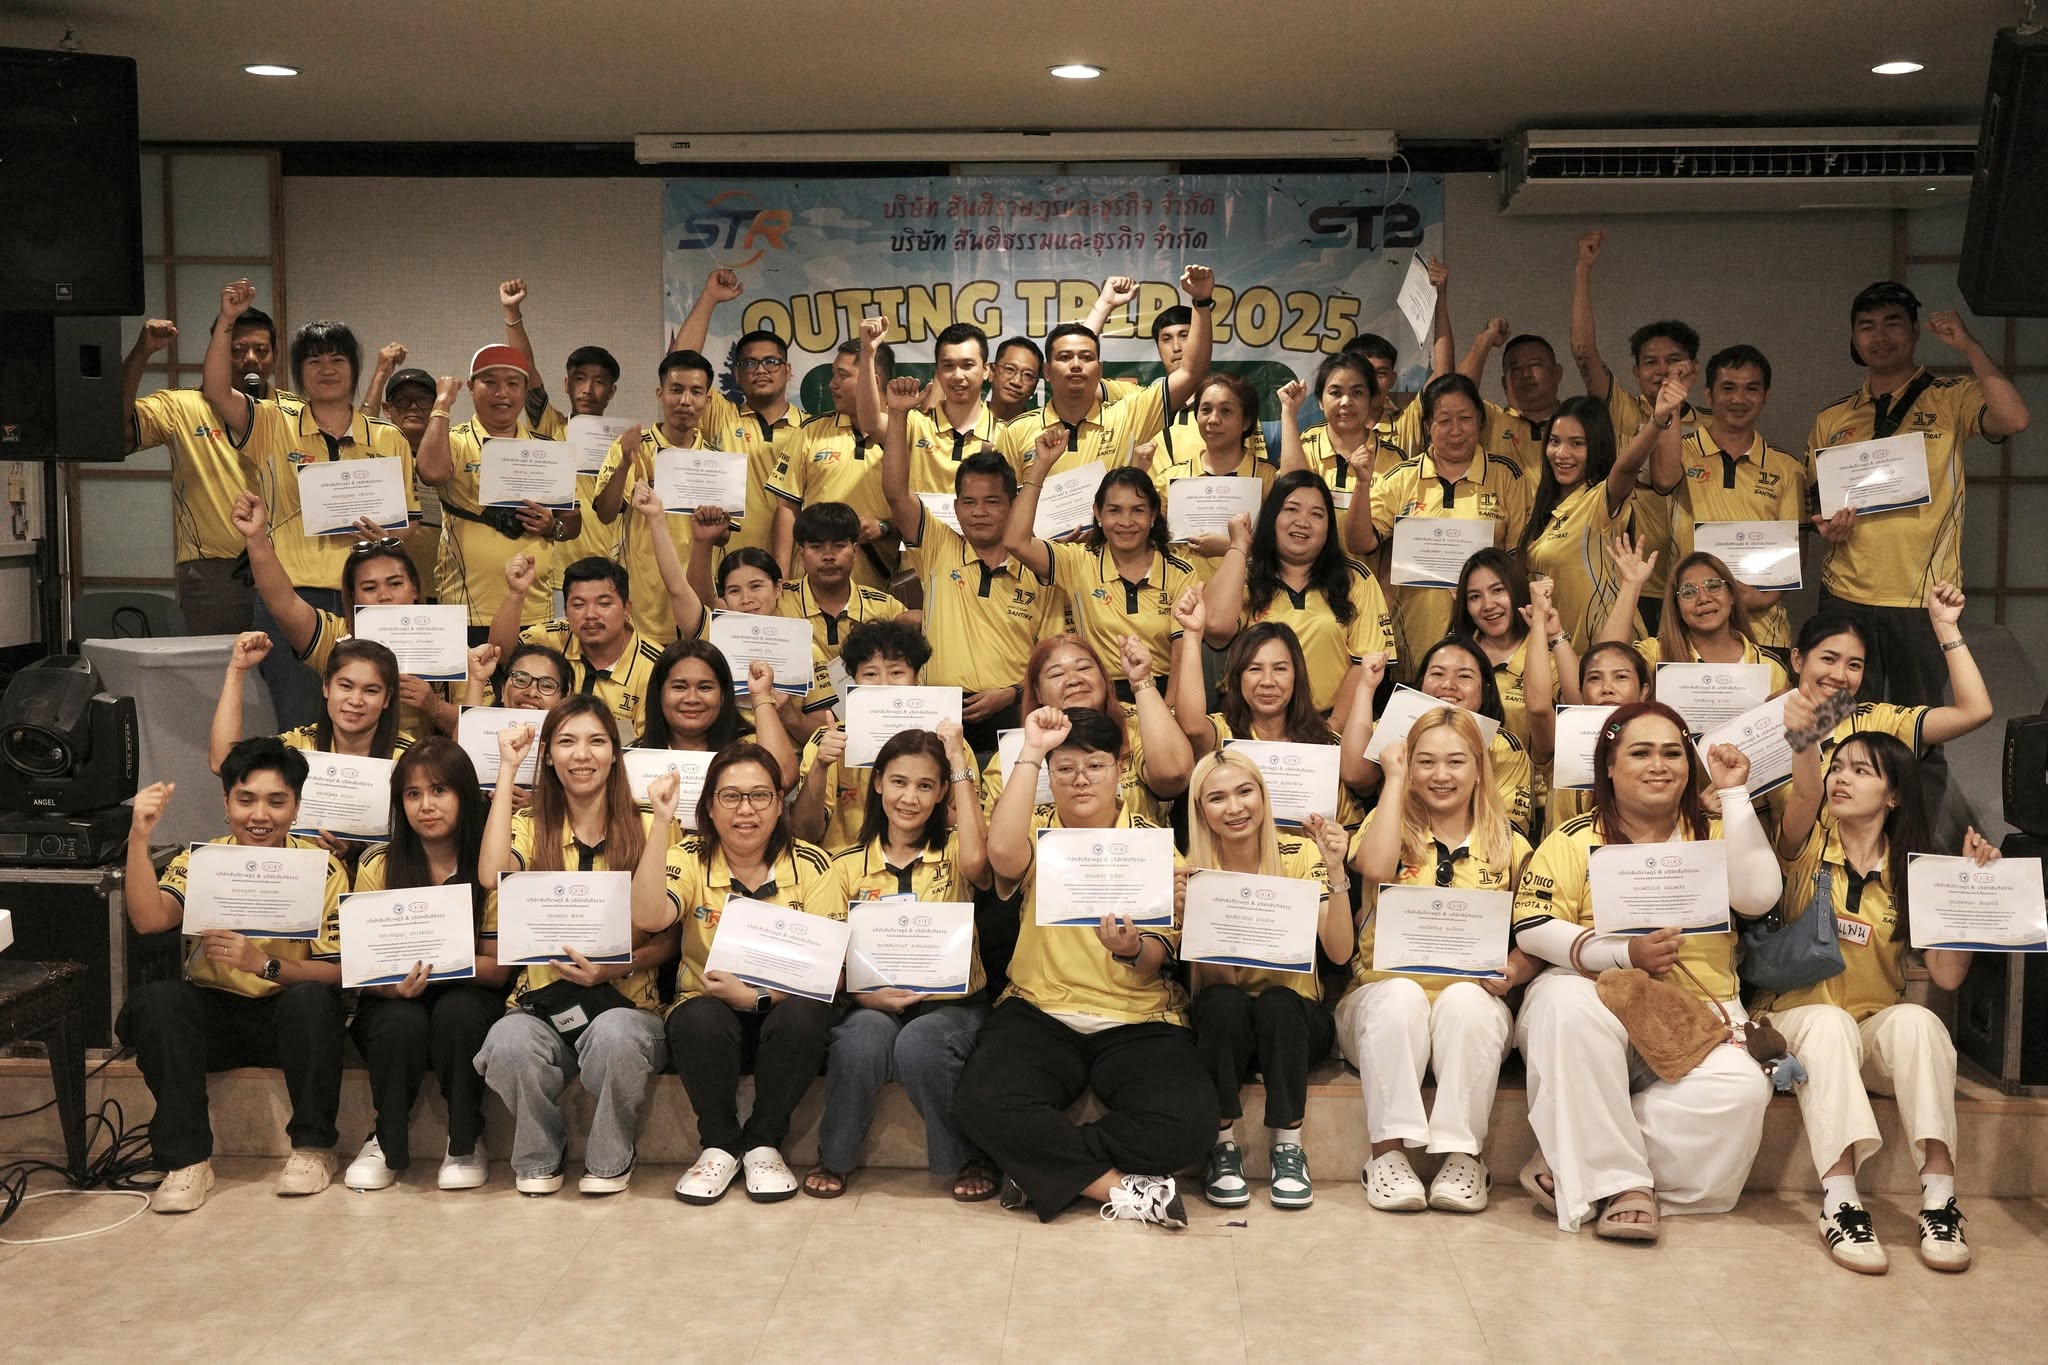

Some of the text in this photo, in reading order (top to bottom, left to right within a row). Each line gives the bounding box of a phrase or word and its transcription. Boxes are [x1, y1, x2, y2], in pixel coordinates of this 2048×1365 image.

[882, 194, 939, 218] บริษัท
[1161, 189, 1215, 217] จำกัด
[678, 208, 792, 249] STR
[890, 224, 1208, 257] บริษัท สันติธรรมและธุรกิจ จำกัด
[743, 280, 1002, 354] OUTING
[1210, 284, 1361, 355] 2025
[1912, 412, 1936, 426] 17
[813, 451, 841, 462] STR
[464, 462, 480, 473] ST
[1687, 468, 1711, 480] STR
[1758, 472, 1781, 487] 17
[1480, 493, 1500, 506] 17
[1013, 588, 1036, 606] 17
[1479, 868, 1503, 884] 17
[1533, 875, 1554, 888] TISCO
[1514, 900, 1541, 909] OYOTA
